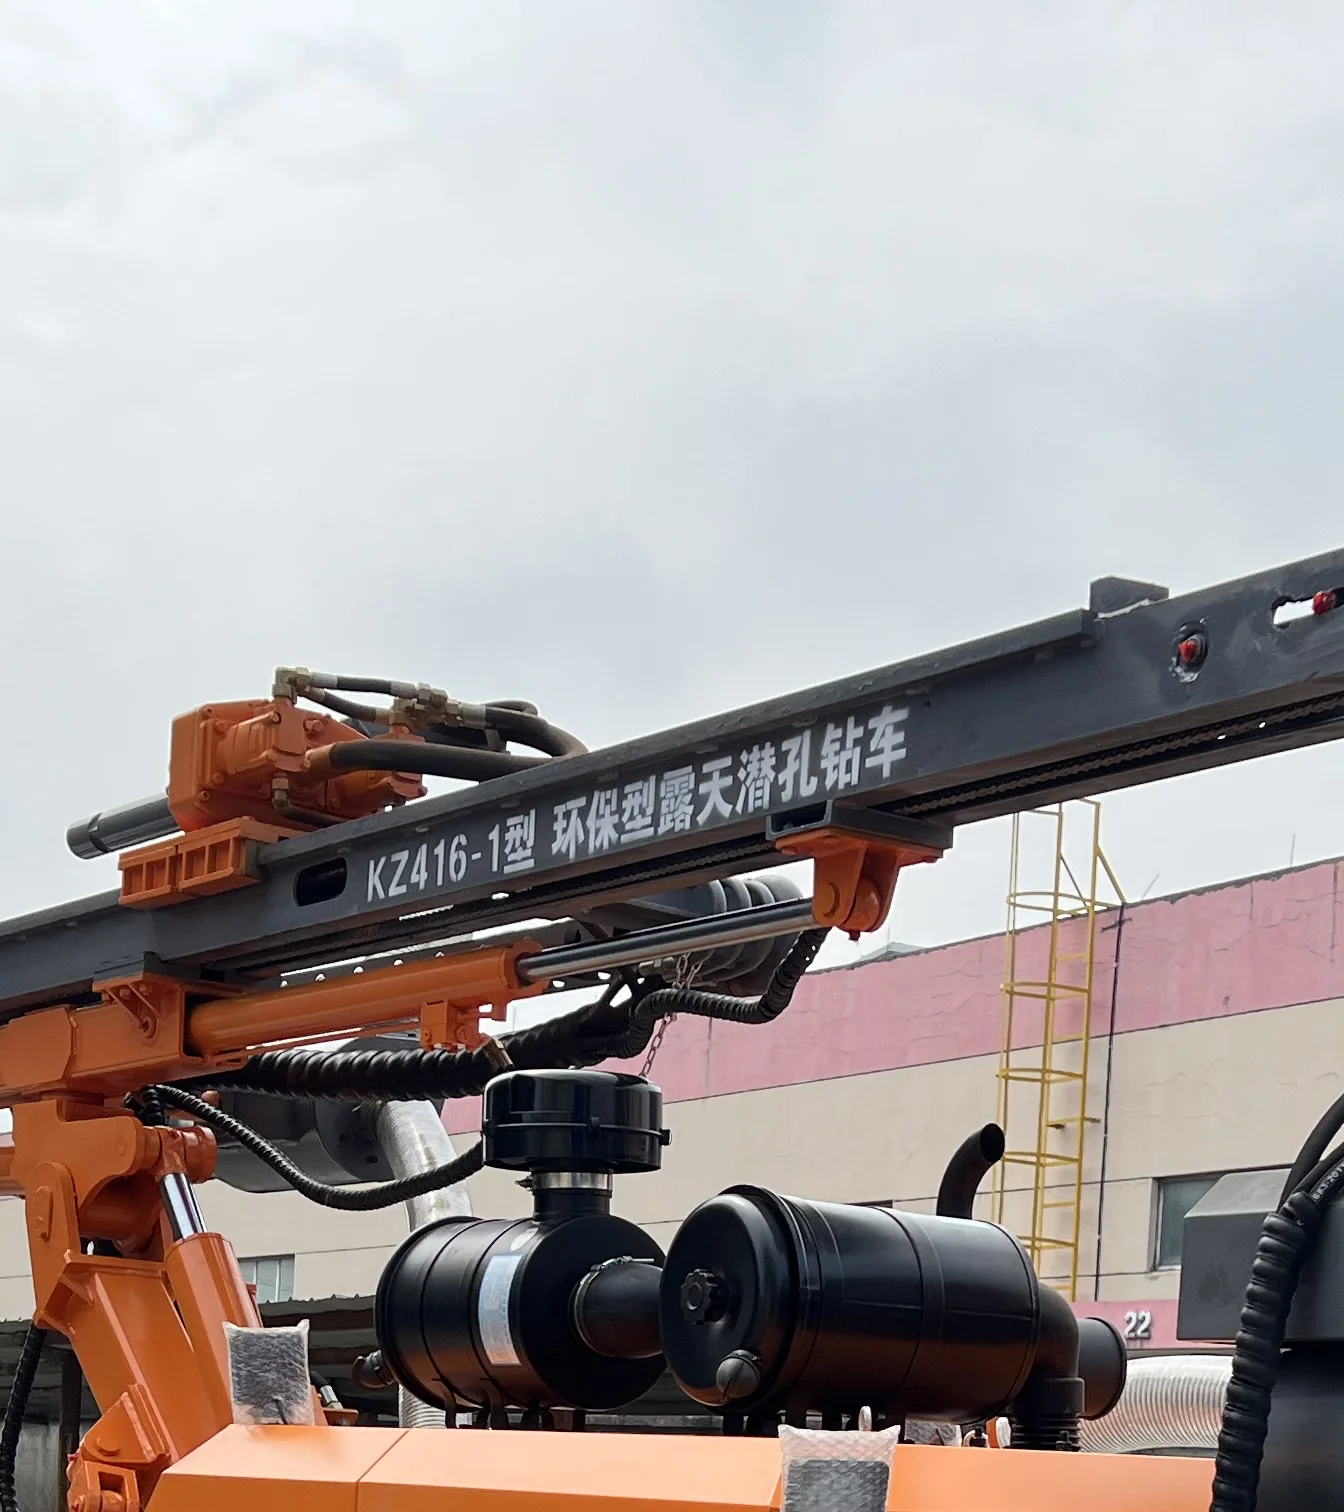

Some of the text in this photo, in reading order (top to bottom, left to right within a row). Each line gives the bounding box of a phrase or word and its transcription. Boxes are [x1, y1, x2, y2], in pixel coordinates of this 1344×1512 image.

[366, 706, 909, 903] KZ416-1型 环保型露天潜孔钻车
[1124, 1310, 1152, 1340] 22
